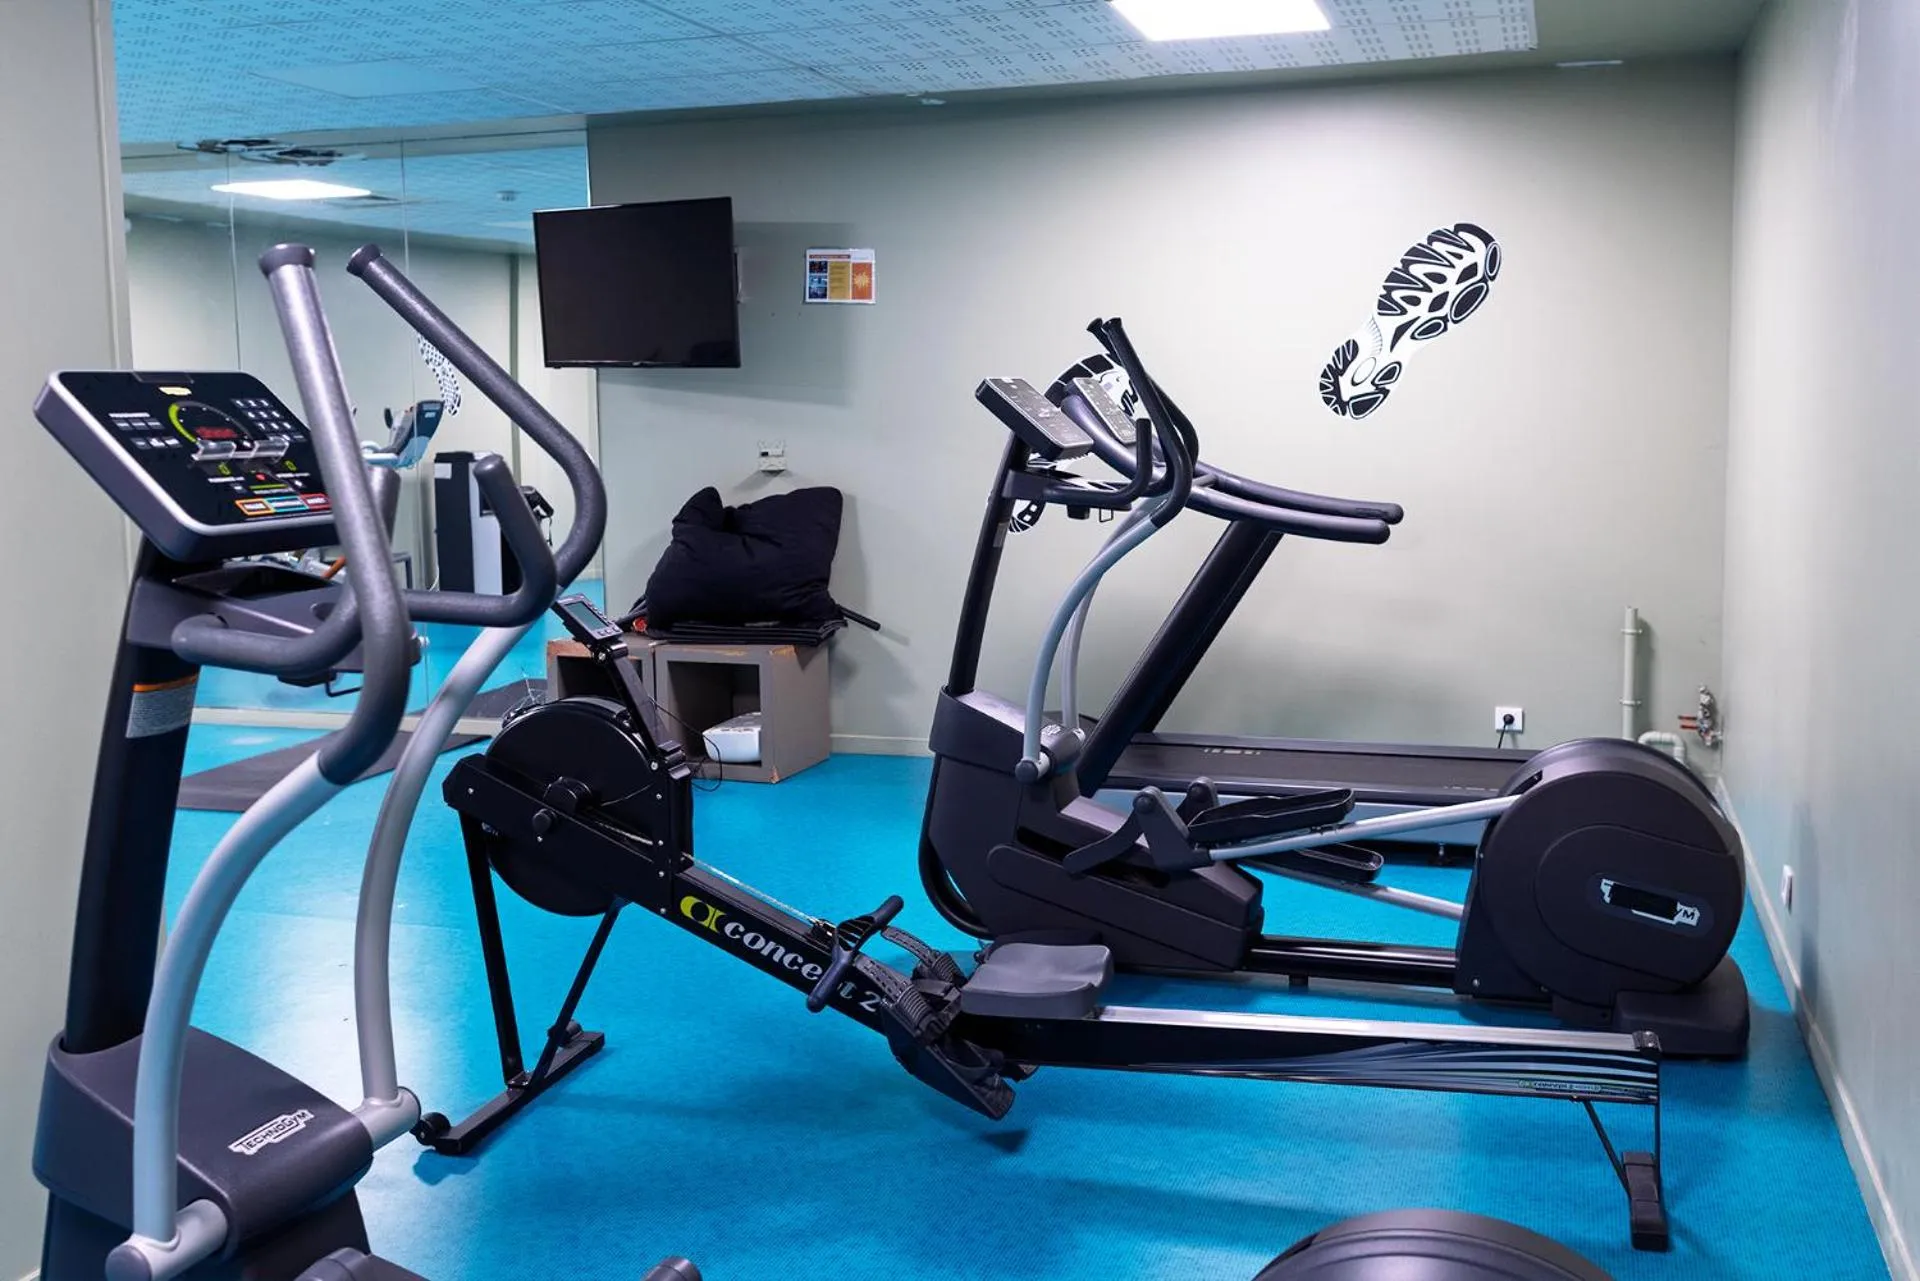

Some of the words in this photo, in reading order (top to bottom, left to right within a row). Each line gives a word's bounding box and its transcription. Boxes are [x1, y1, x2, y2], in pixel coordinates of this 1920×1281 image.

[723, 921, 857, 1000] concet
[860, 990, 882, 1013] 2
[233, 1111, 309, 1150] TECHNOGYM
